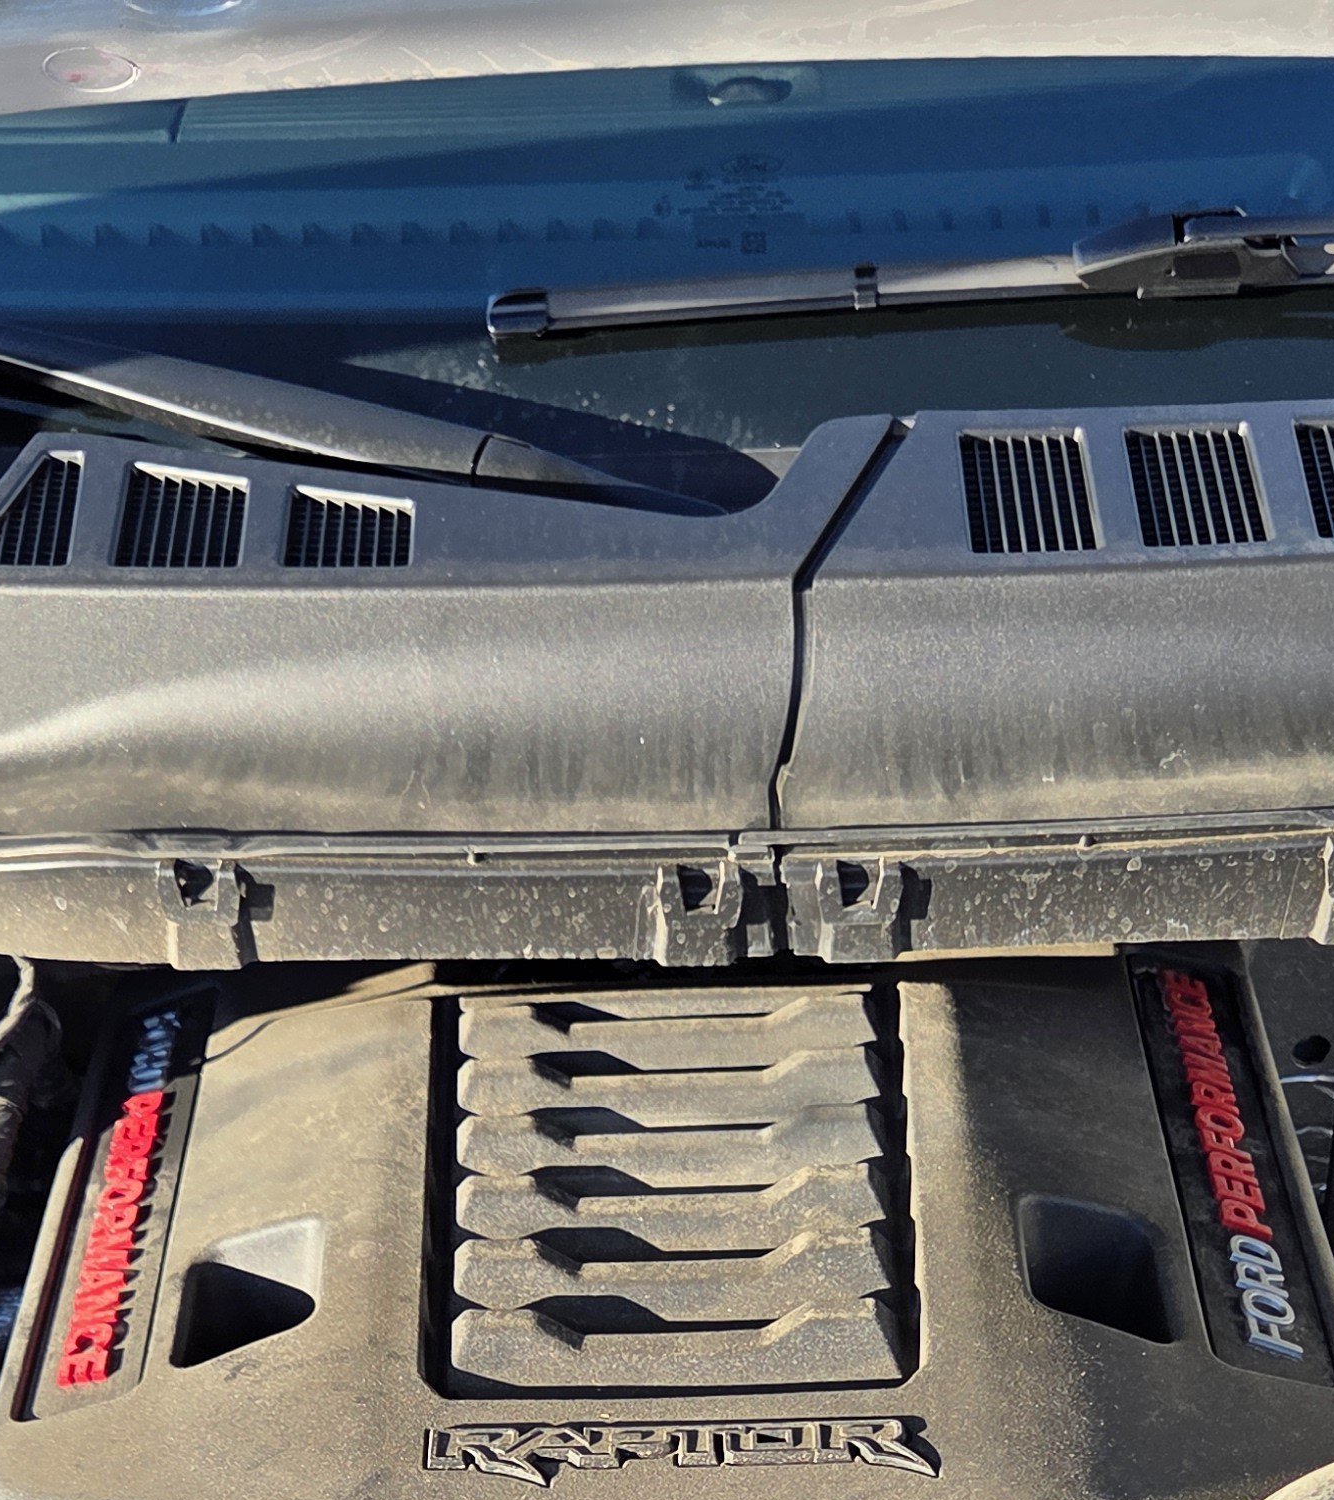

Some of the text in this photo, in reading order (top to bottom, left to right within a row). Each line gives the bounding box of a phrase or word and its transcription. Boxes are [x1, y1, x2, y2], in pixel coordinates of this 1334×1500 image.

[56, 1089, 164, 1391] PERFORMANCE
[1159, 969, 1304, 1361] FORD PERFORMANCE
[424, 1422, 941, 1487] RAPTOR
